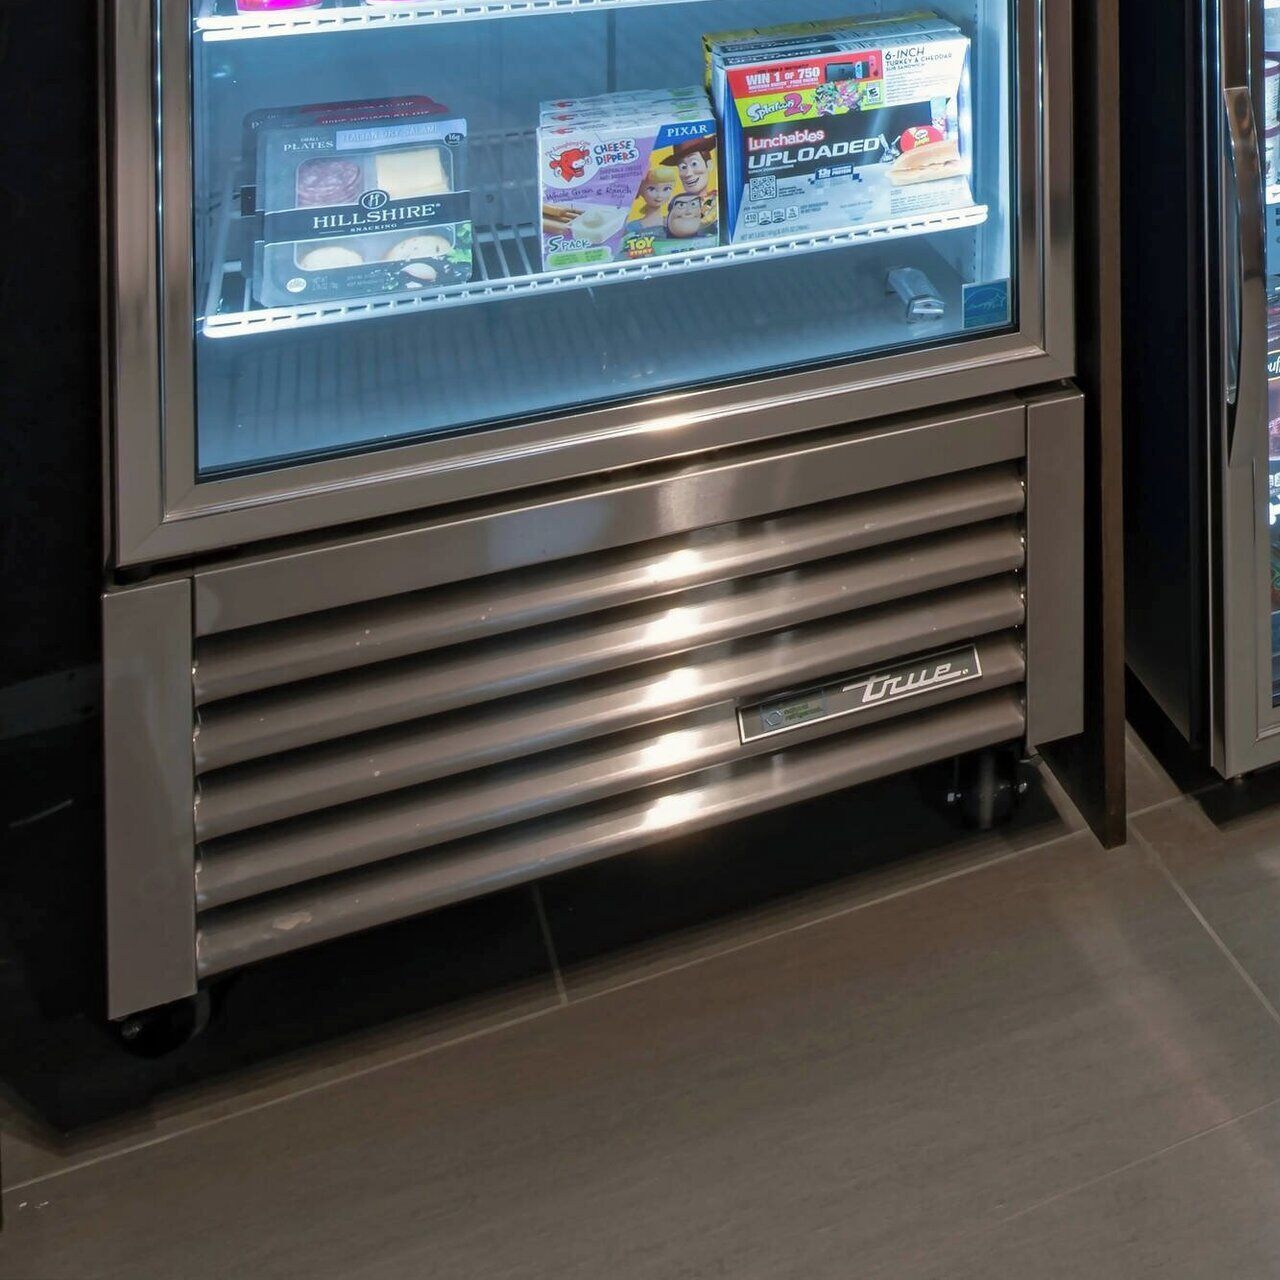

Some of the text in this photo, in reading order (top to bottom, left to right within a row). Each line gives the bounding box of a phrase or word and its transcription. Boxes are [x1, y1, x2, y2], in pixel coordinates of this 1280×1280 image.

[885, 47, 925, 60] 6-INCH
[746, 67, 821, 85] WIN 750
[667, 125, 708, 138] PIXAR
[283, 140, 334, 152] PLATES
[594, 139, 633, 155] CHEESE
[749, 130, 825, 152] Lunchables
[595, 150, 635, 166] DIPPERS
[748, 137, 881, 169] UPLOADED
[312, 203, 437, 230] HILLSHIRE
[350, 223, 398, 233] SNACKING
[627, 237, 655, 249] TOY
